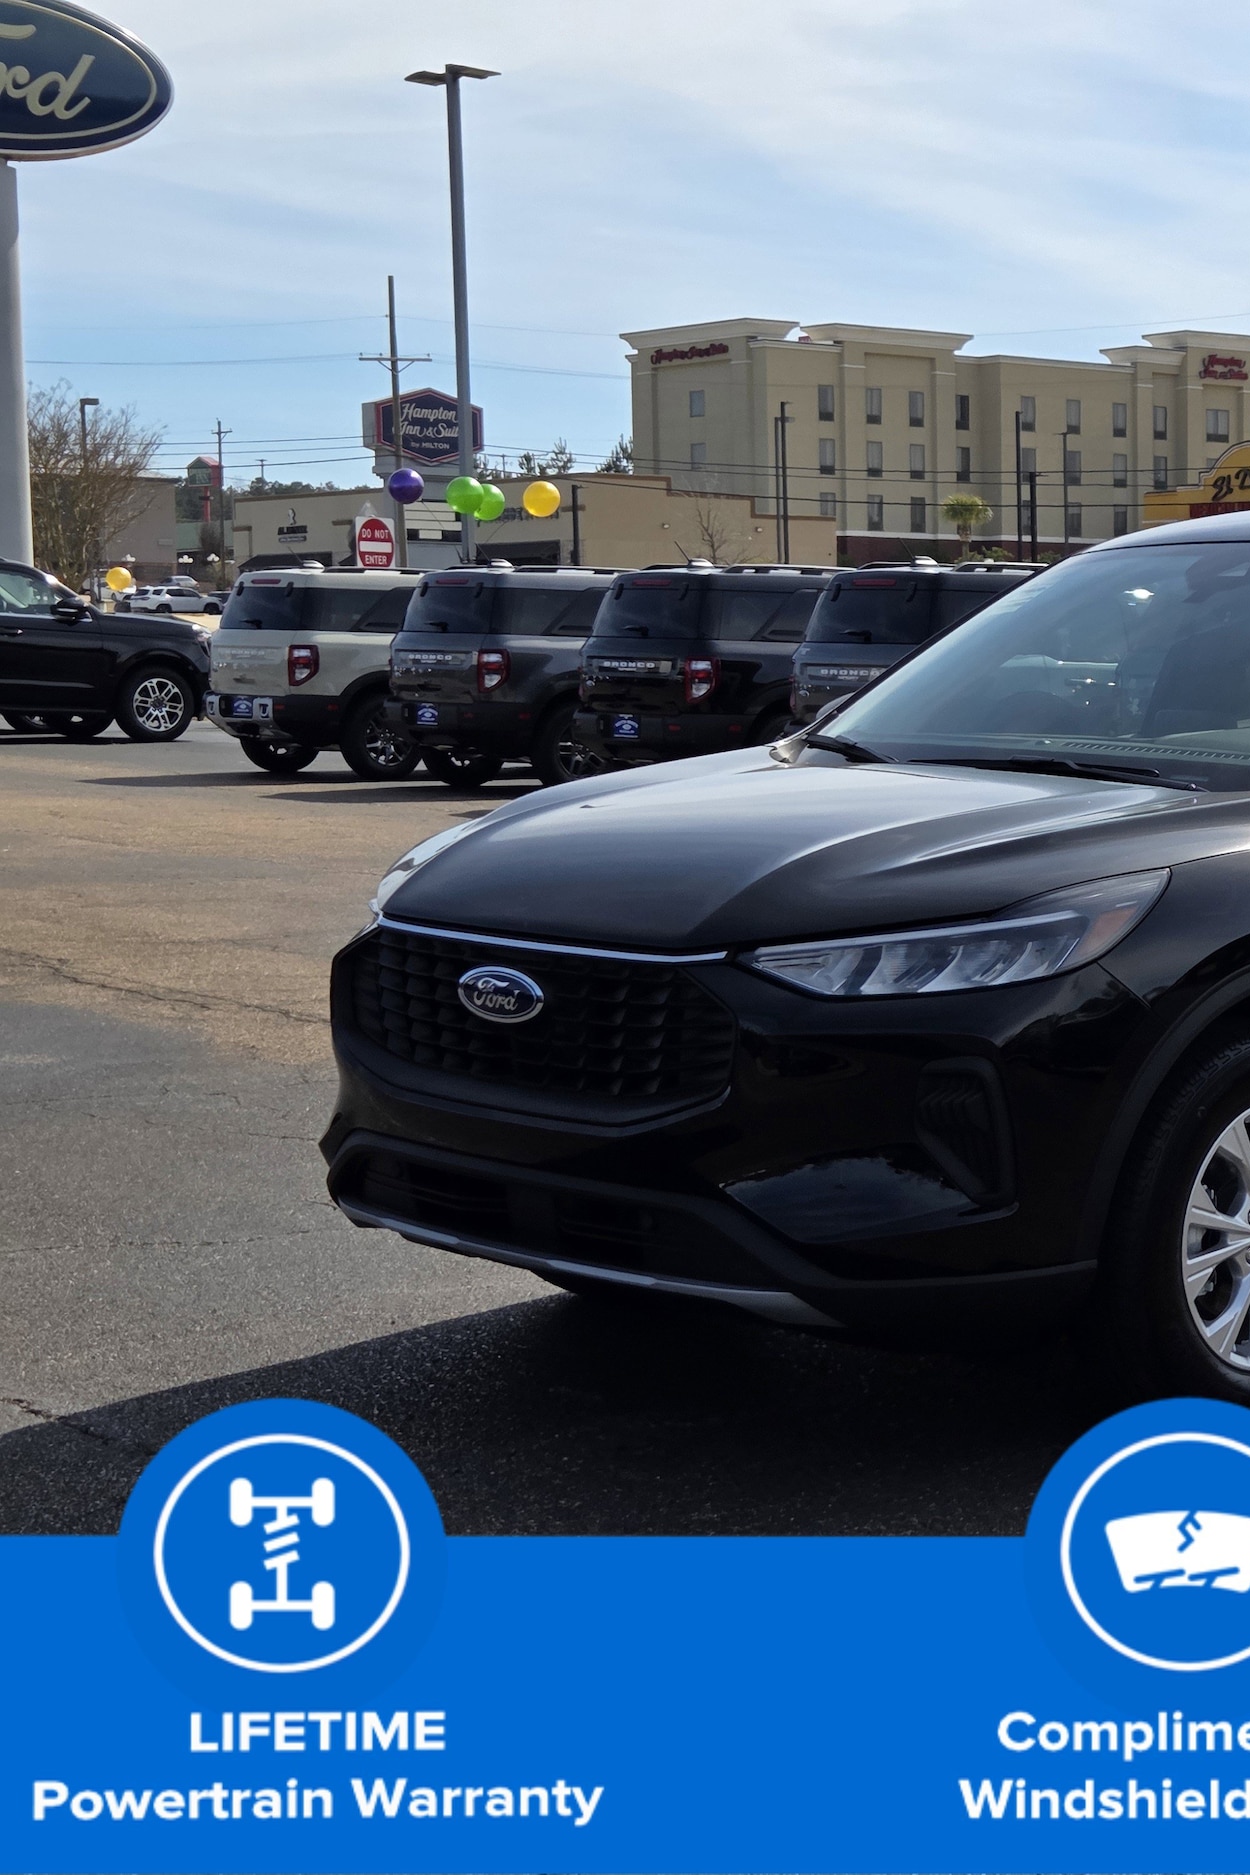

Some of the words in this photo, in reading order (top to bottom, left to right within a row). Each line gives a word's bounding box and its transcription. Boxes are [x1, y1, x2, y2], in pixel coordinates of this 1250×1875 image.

[401, 403, 459, 423] Hampton
[426, 428, 434, 436] &
[1211, 474, 1234, 502] El
[361, 528, 372, 539] DO
[374, 529, 389, 539] NOT
[365, 555, 388, 565] ENTER
[603, 660, 656, 669] BRONCO
[473, 976, 521, 1011] Ford
